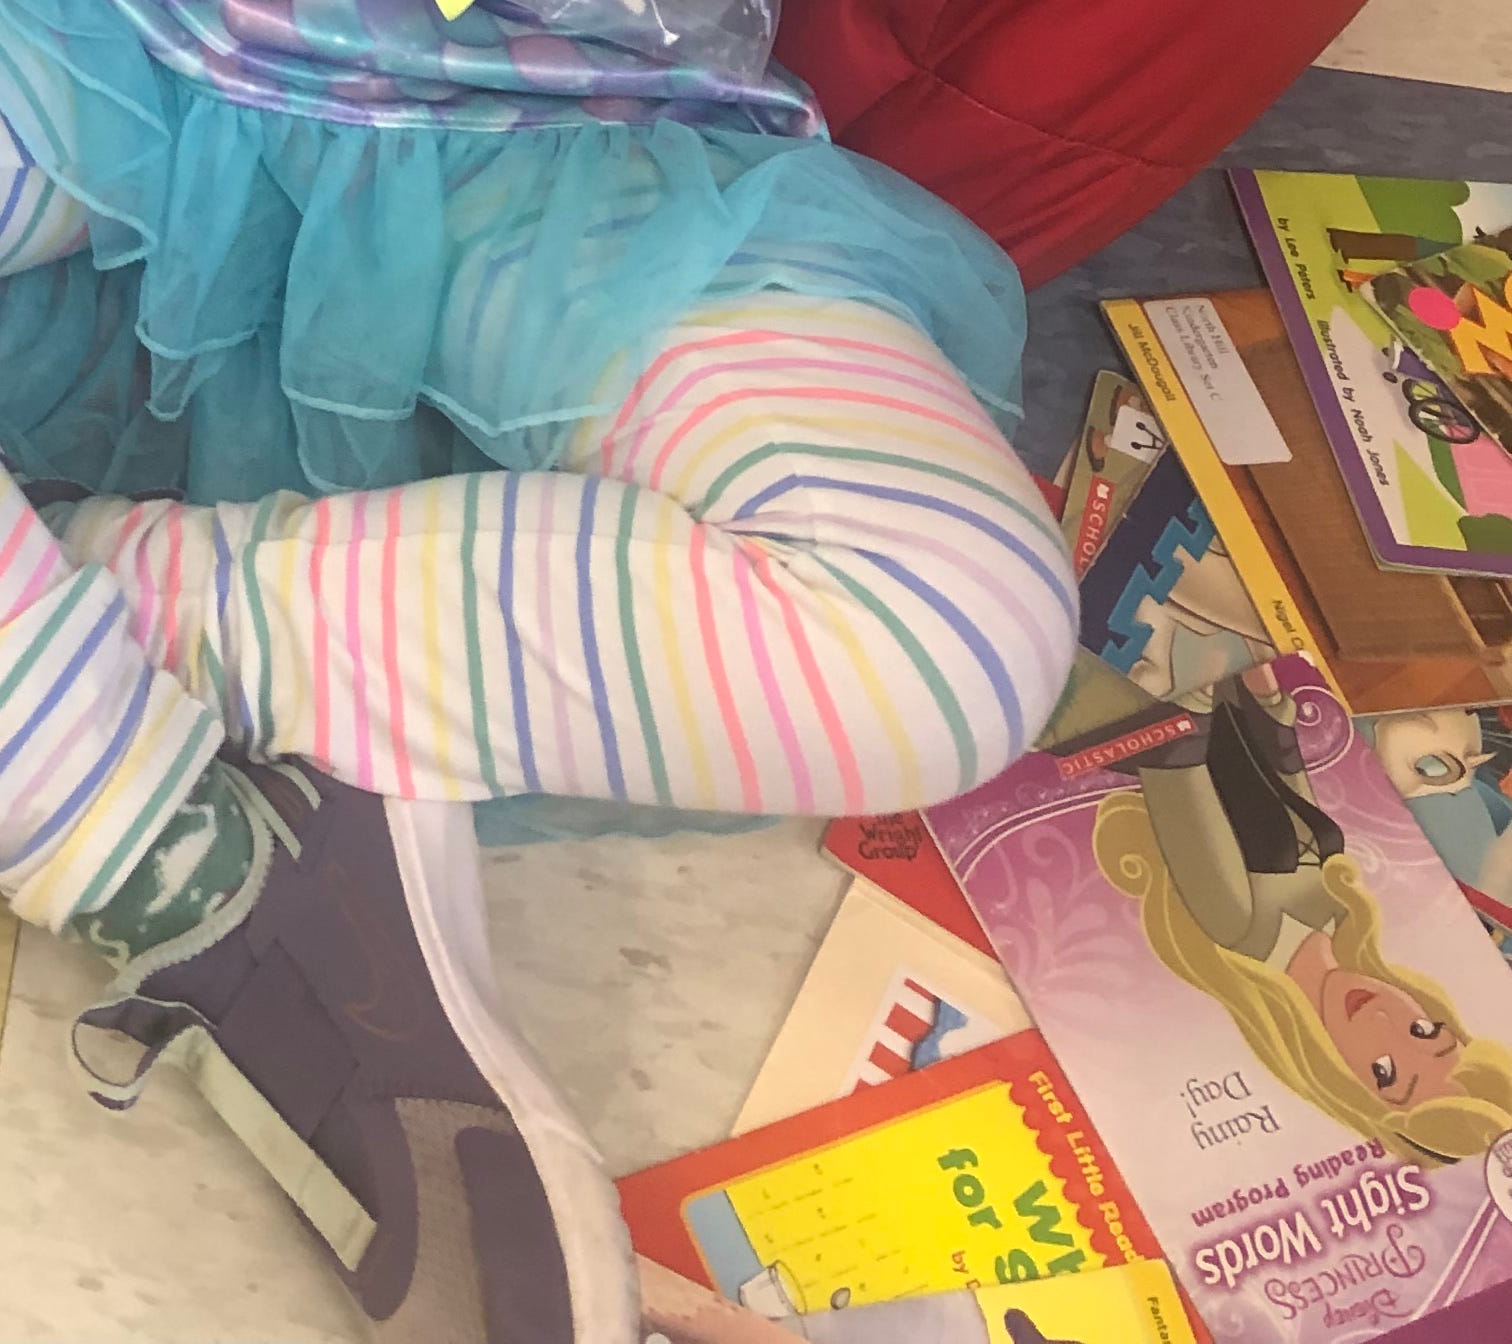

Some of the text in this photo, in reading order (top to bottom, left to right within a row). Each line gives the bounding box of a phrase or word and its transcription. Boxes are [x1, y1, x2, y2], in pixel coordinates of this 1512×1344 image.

[1278, 217, 1316, 301] by Lee Peters
[1316, 319, 1390, 487] Illustrated by Noah Jones
[1076, 499, 1107, 568] SCHOL
[1061, 724, 1177, 775] SCHOLASTIC
[859, 840, 919, 861] Group
[1028, 1070, 1073, 1123] First
[1066, 1130, 1105, 1197] Little
[1180, 1071, 1252, 1118] Day!
[1191, 1105, 1281, 1150] Rainy
[937, 1148, 1003, 1230] for
[1191, 1136, 1386, 1228] Reading Program
[951, 1250, 969, 1274] by
[1195, 1165, 1431, 1288] Sight Words
[1264, 1223, 1426, 1320] PRINCESS
